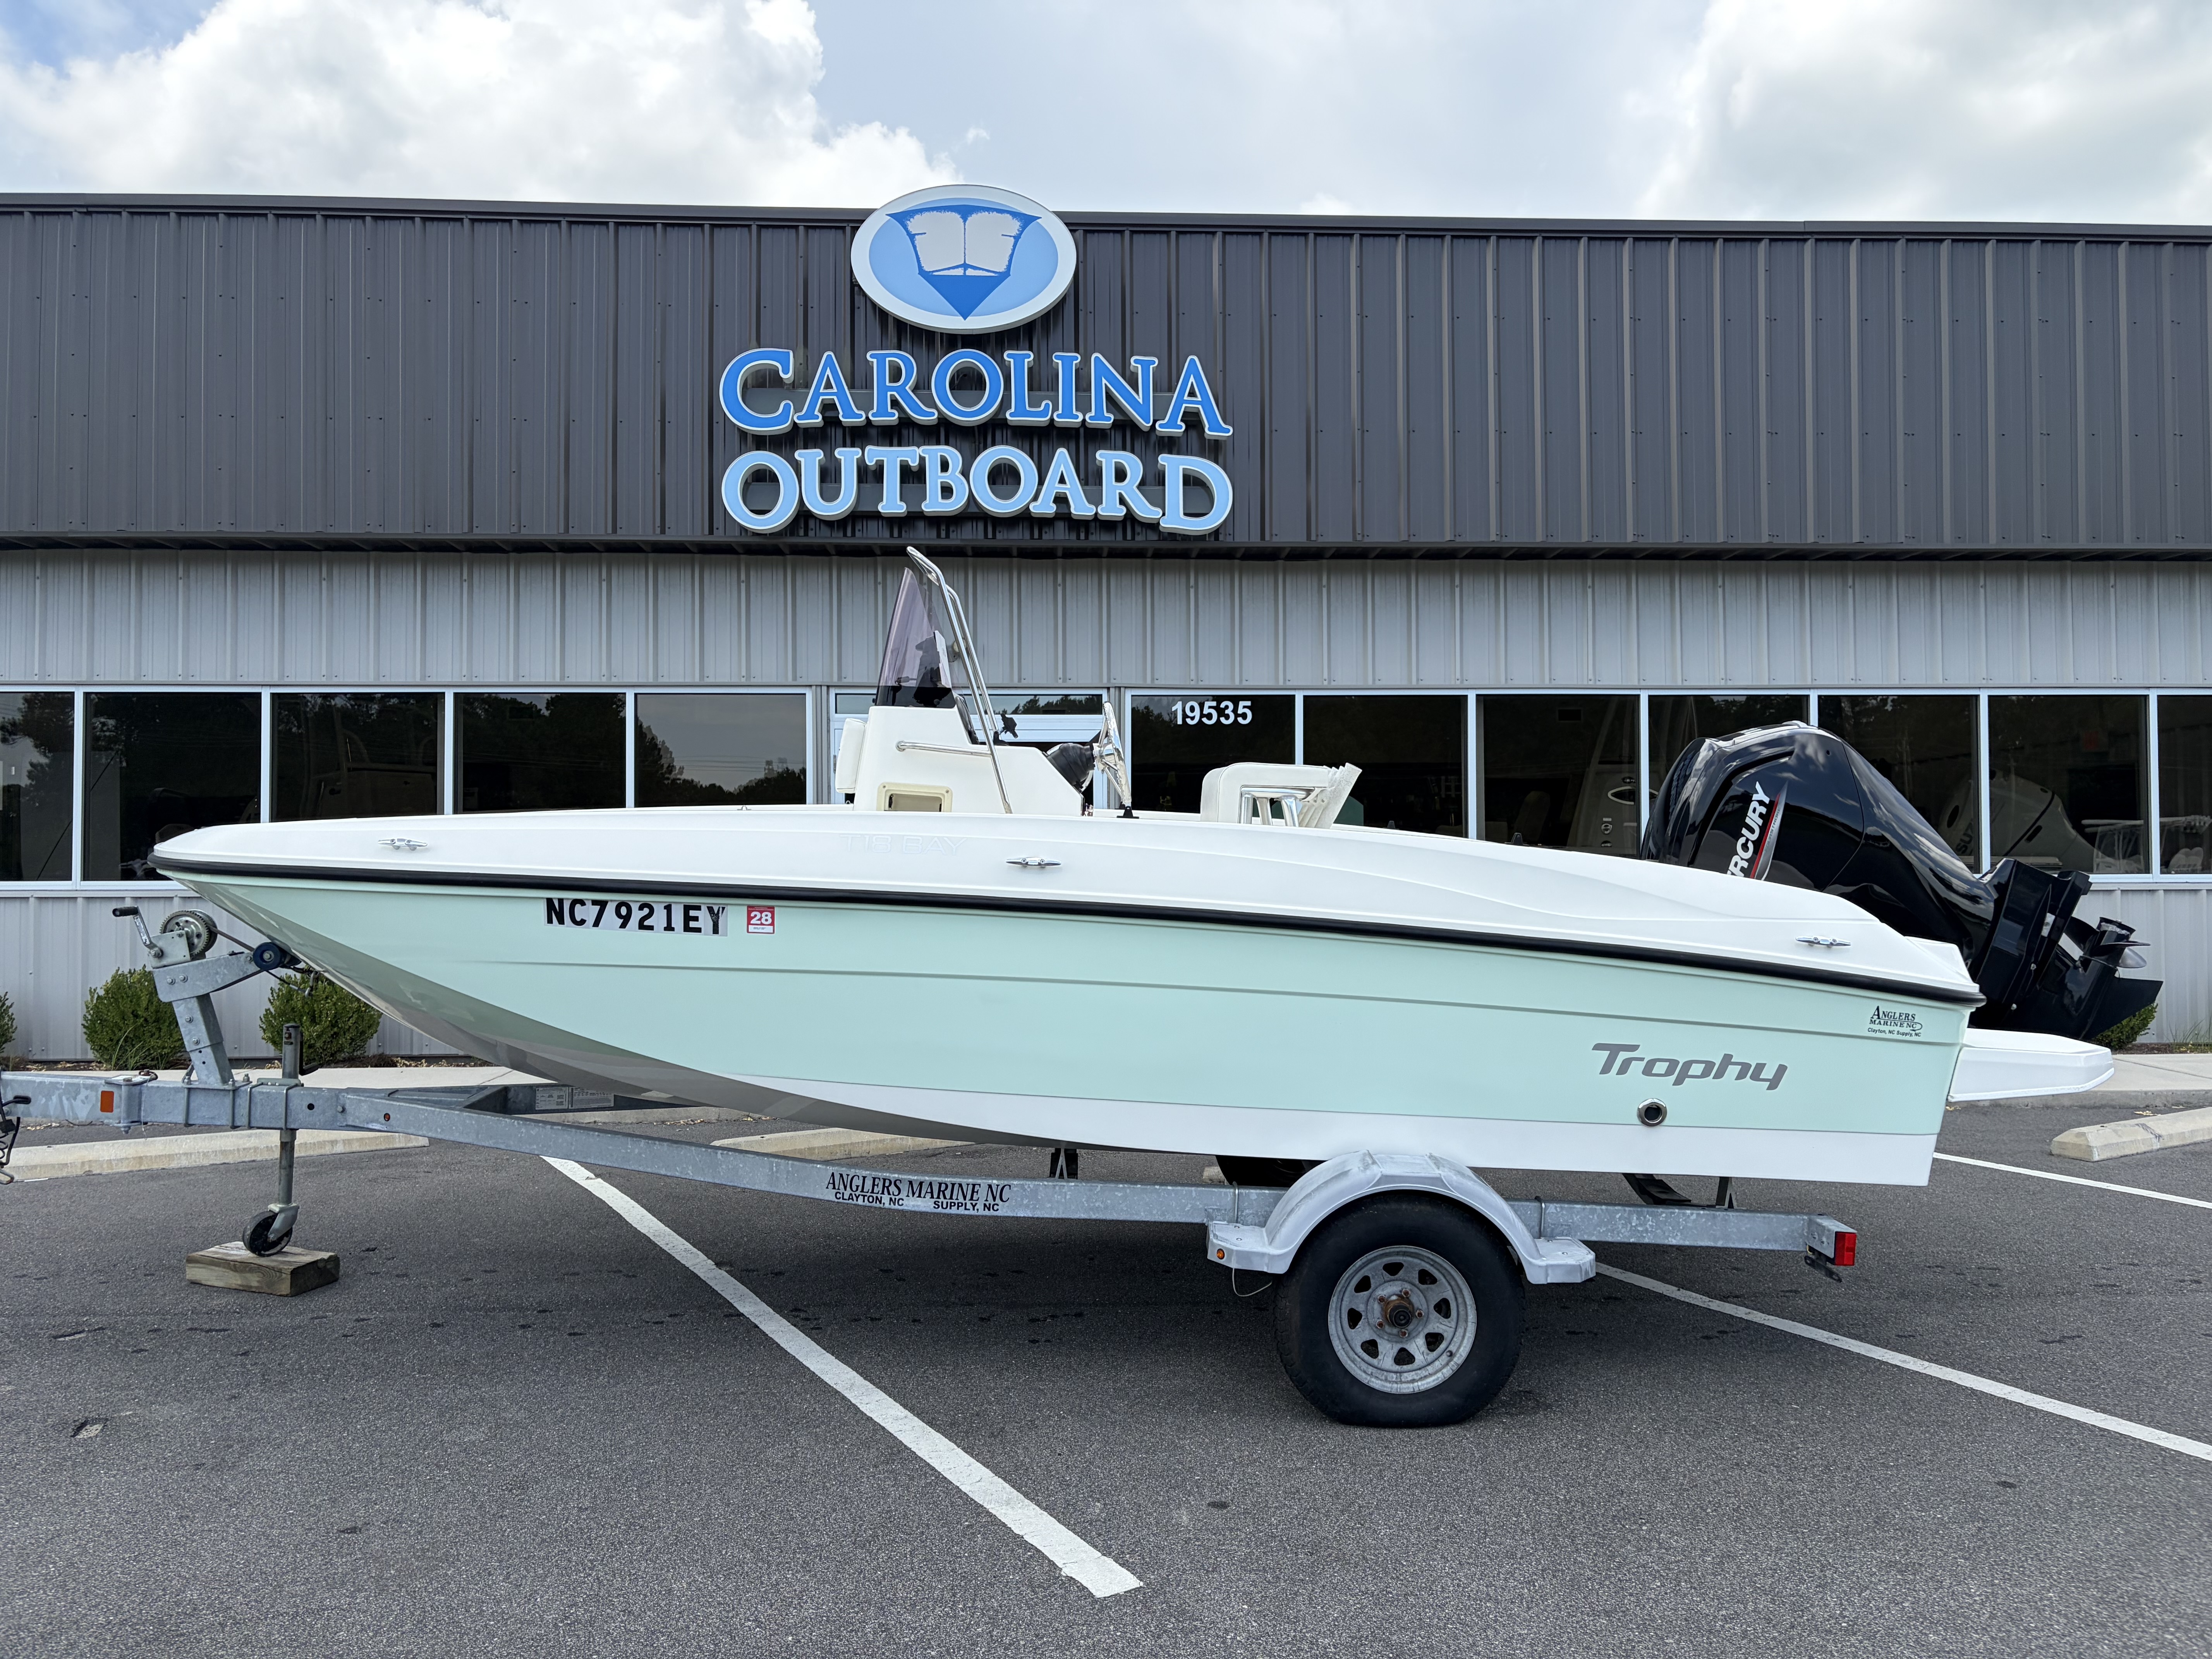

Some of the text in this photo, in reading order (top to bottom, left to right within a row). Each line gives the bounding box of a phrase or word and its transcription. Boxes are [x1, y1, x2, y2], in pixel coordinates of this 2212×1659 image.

[719, 348, 1233, 440] CAROLINA
[721, 445, 1233, 534] OUTBOARD
[1172, 701, 1252, 725] 19535
[1727, 781, 1770, 877] RCURY
[840, 835, 967, 855] T18 BAY
[546, 898, 725, 934] NC7921EY
[750, 911, 772, 924] 28
[1869, 1019, 1905, 1027] MARINE
[1870, 1005, 1916, 1021] ANGLERS
[1592, 1043, 1788, 1091] Trophy
[826, 1172, 1011, 1202] ANGLERS MARINE NC
[835, 1192, 999, 1212] CLAYTON, NC SUPPLY, NC
